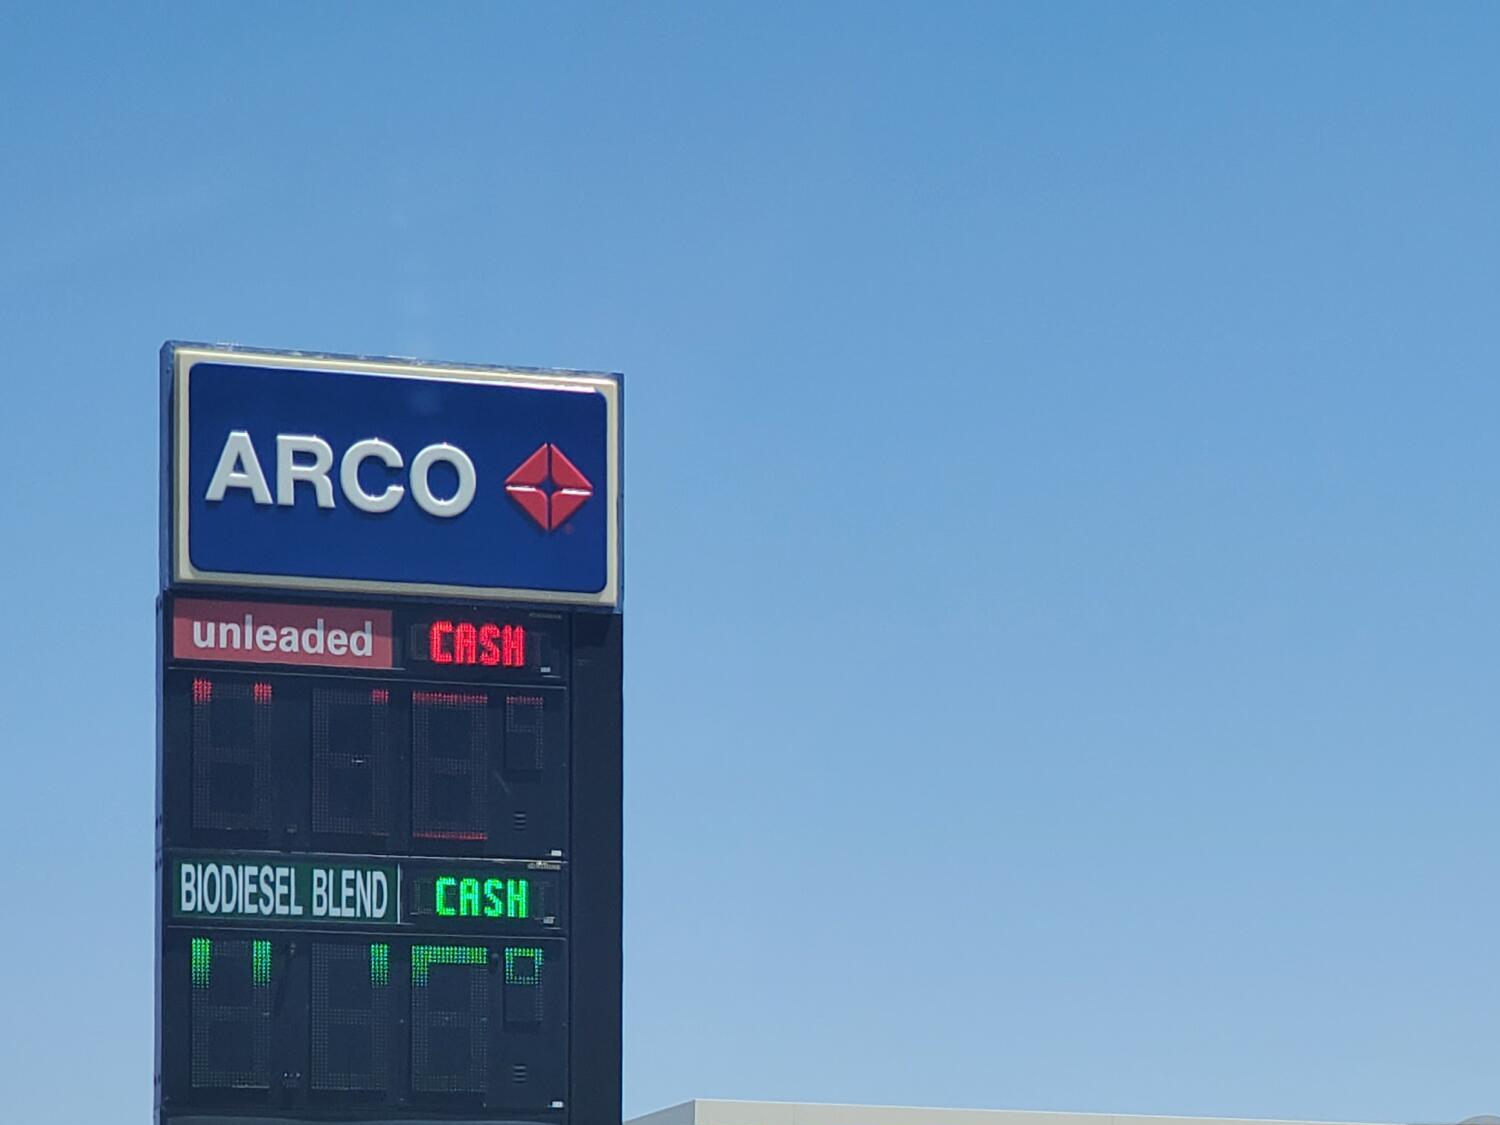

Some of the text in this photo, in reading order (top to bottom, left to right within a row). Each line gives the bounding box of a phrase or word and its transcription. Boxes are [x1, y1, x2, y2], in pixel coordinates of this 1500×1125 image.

[205, 430, 477, 518] ARCO
[193, 615, 373, 657] unleaded
[429, 620, 526, 667] CASH
[180, 863, 388, 919] BIODIESEL BLEND
[435, 877, 529, 918] CASH
